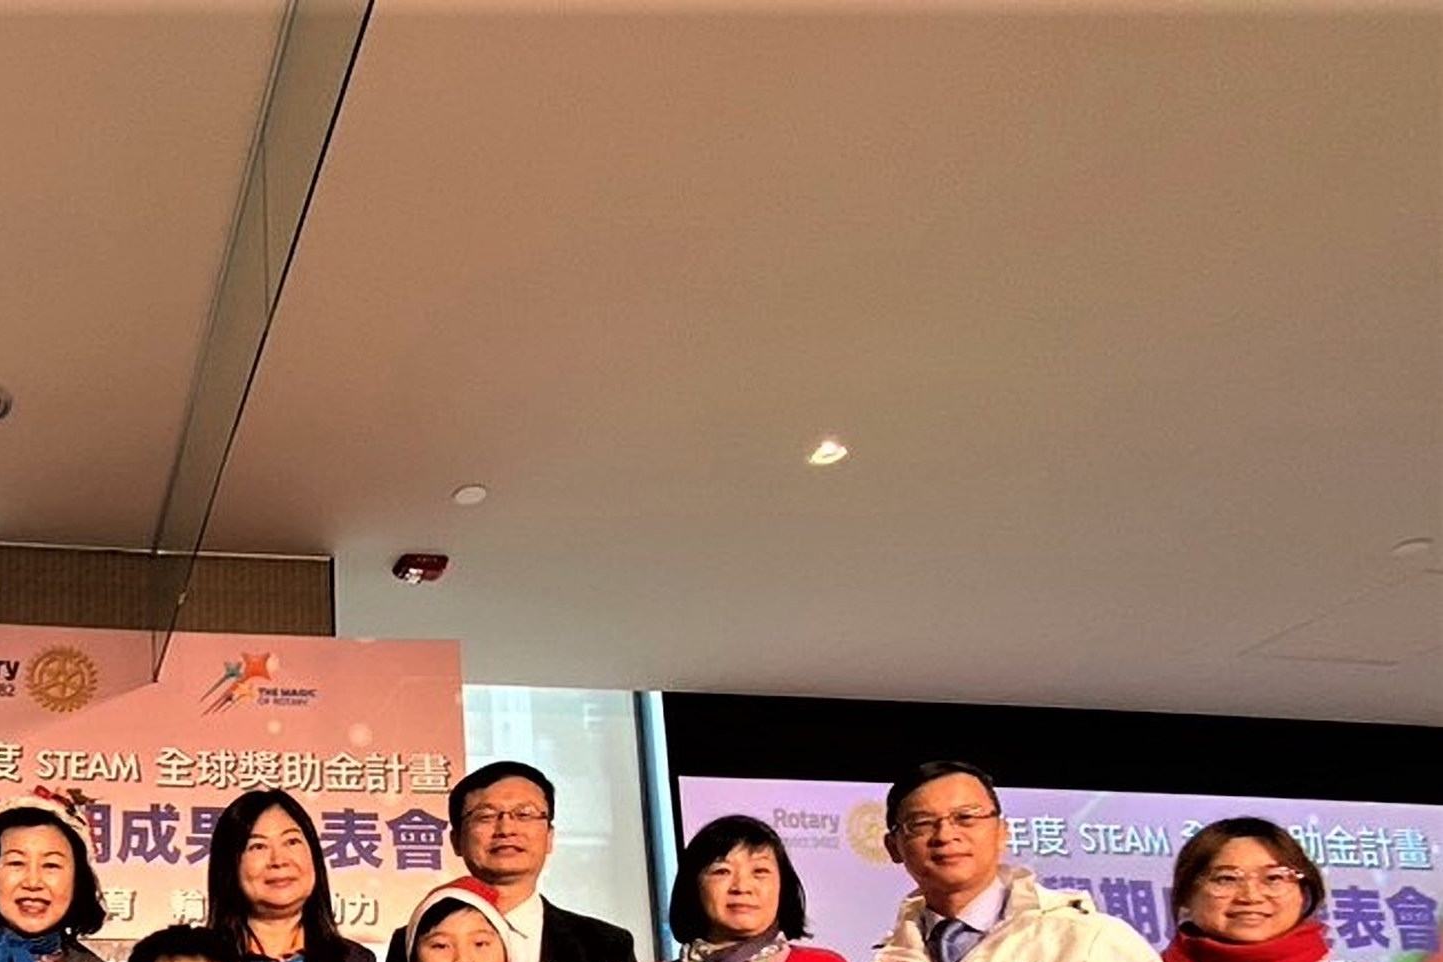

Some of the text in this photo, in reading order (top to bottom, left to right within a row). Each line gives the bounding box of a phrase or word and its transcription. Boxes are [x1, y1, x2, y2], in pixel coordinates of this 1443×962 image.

[37, 749, 142, 783] STEAM
[155, 746, 453, 794] 全球獎助金計畫
[773, 808, 840, 834] Rotary
[1079, 822, 1173, 857] STEAM
